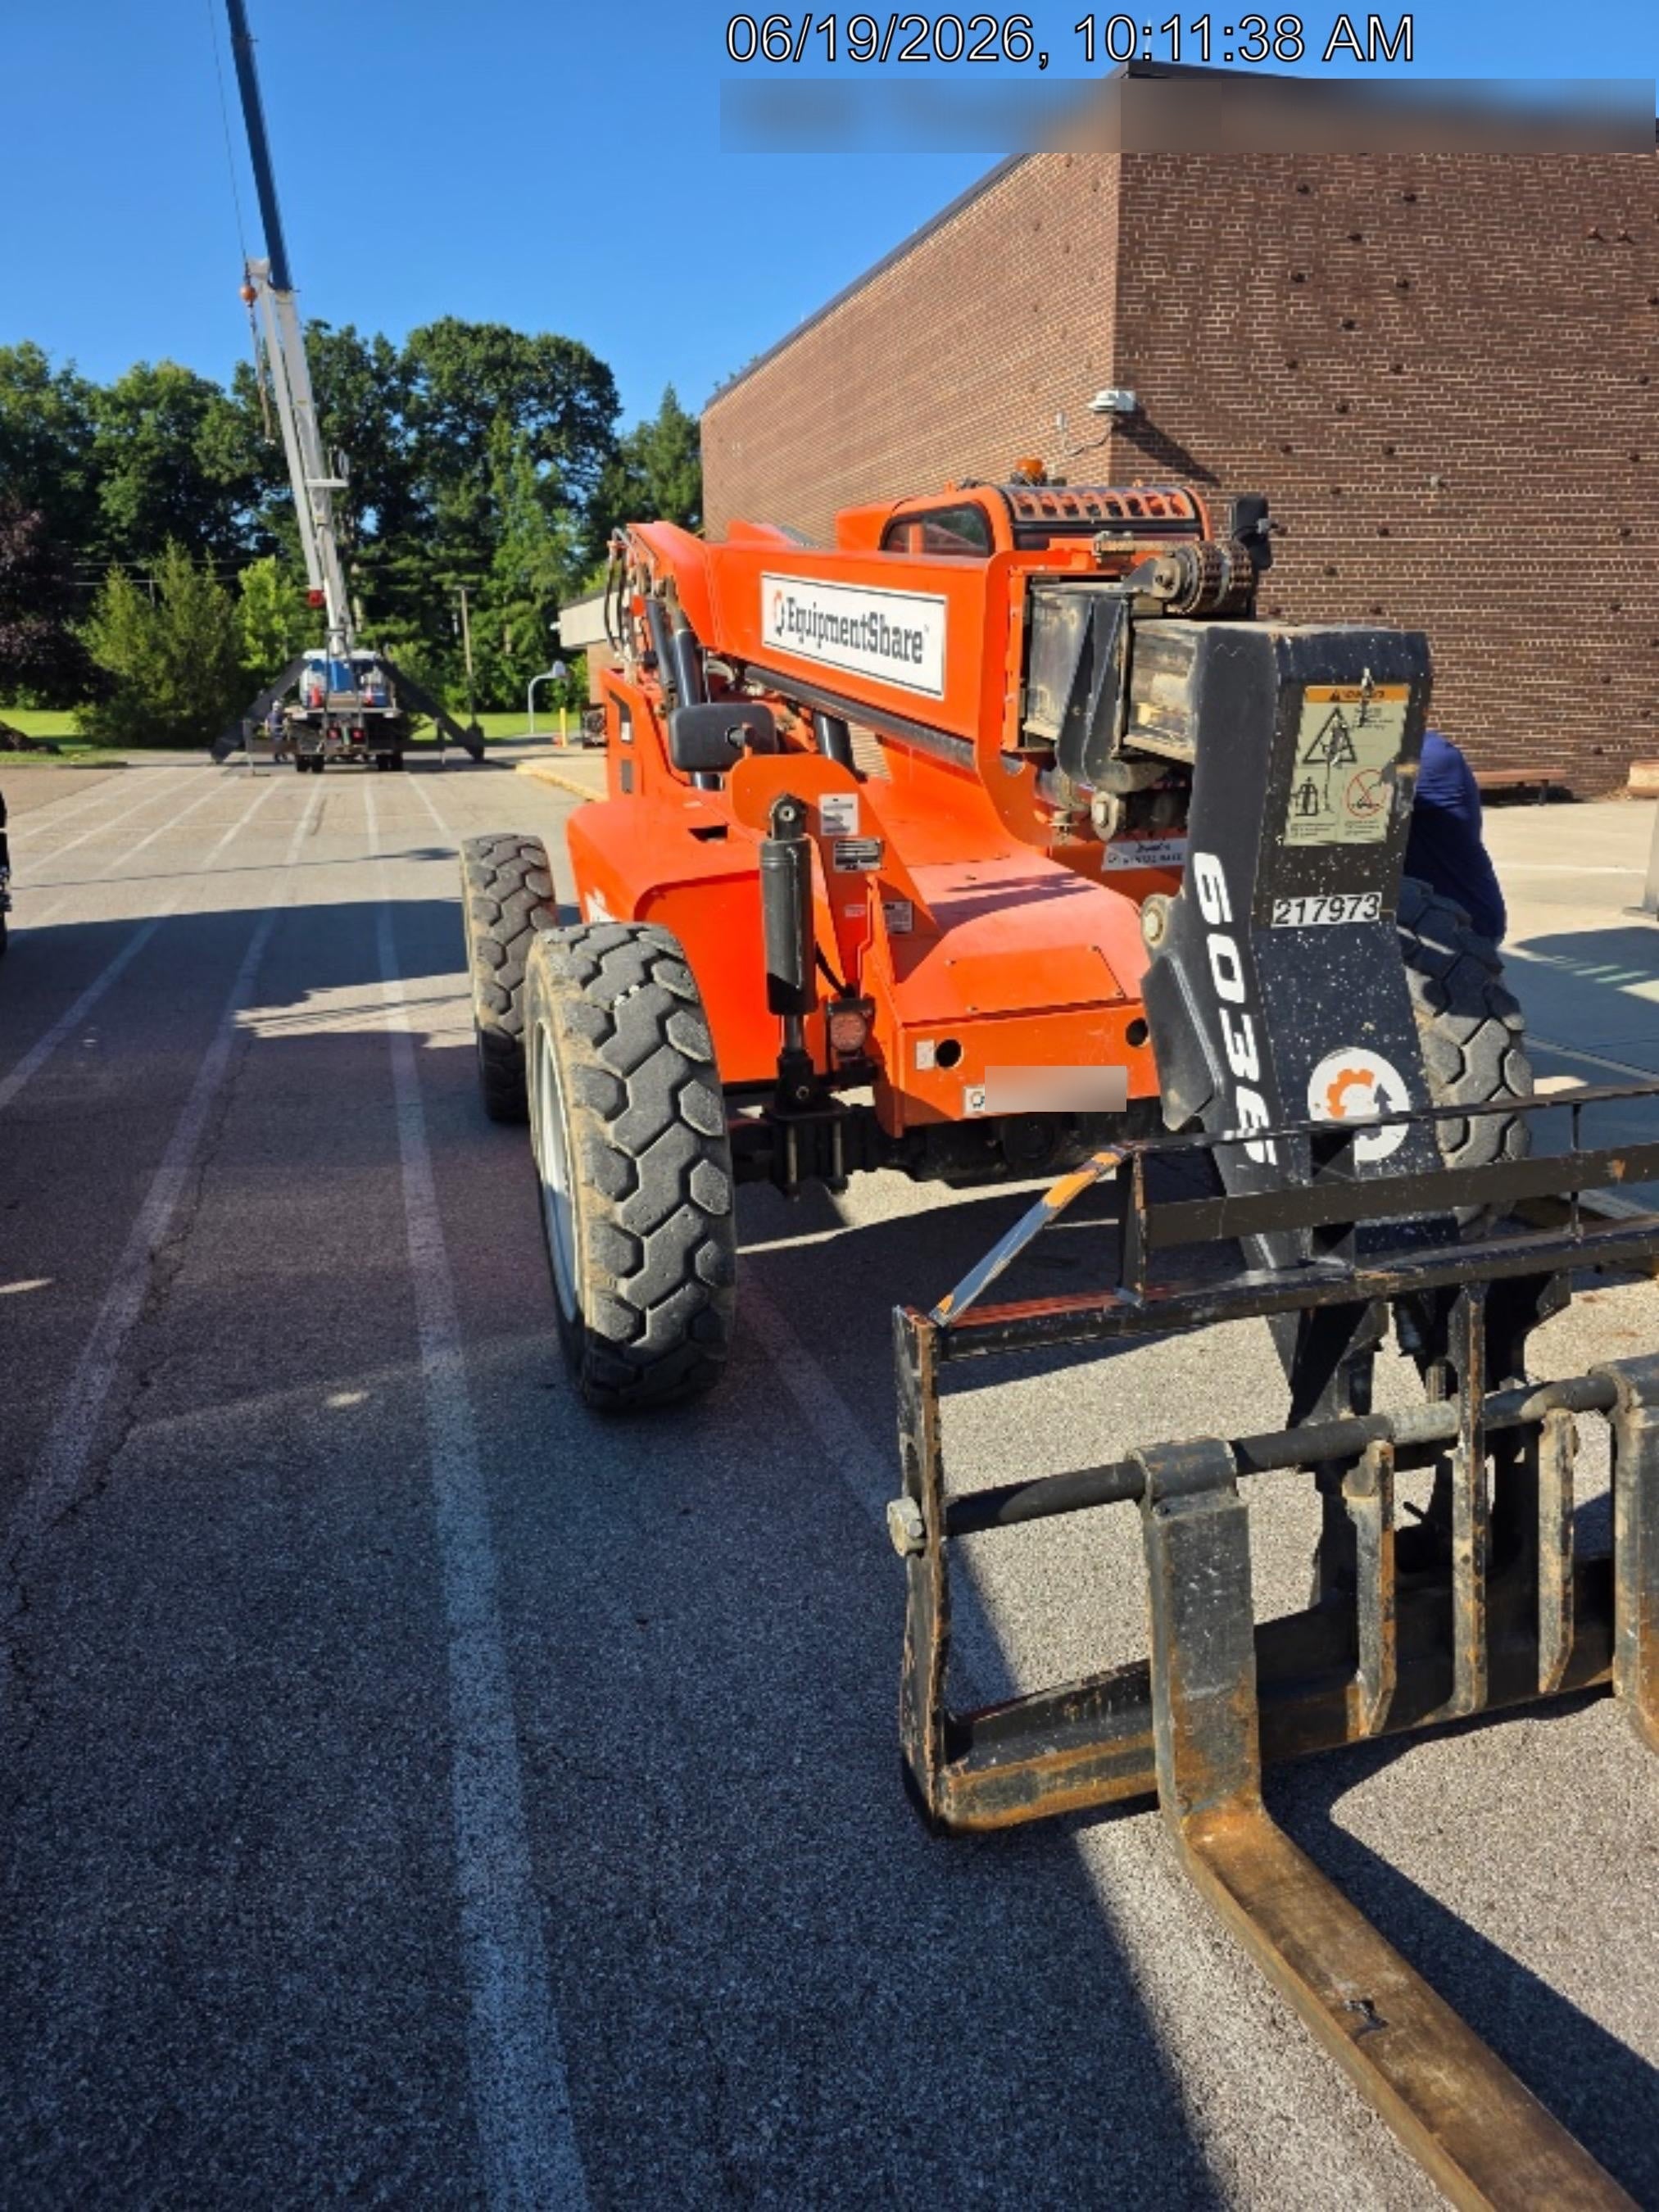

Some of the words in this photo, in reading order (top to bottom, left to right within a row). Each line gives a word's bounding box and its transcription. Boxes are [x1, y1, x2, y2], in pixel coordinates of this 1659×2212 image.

[786, 597, 922, 664] EquipmentShare
[1275, 894, 1380, 924] 217973
[1193, 852, 1278, 1165] 6036
